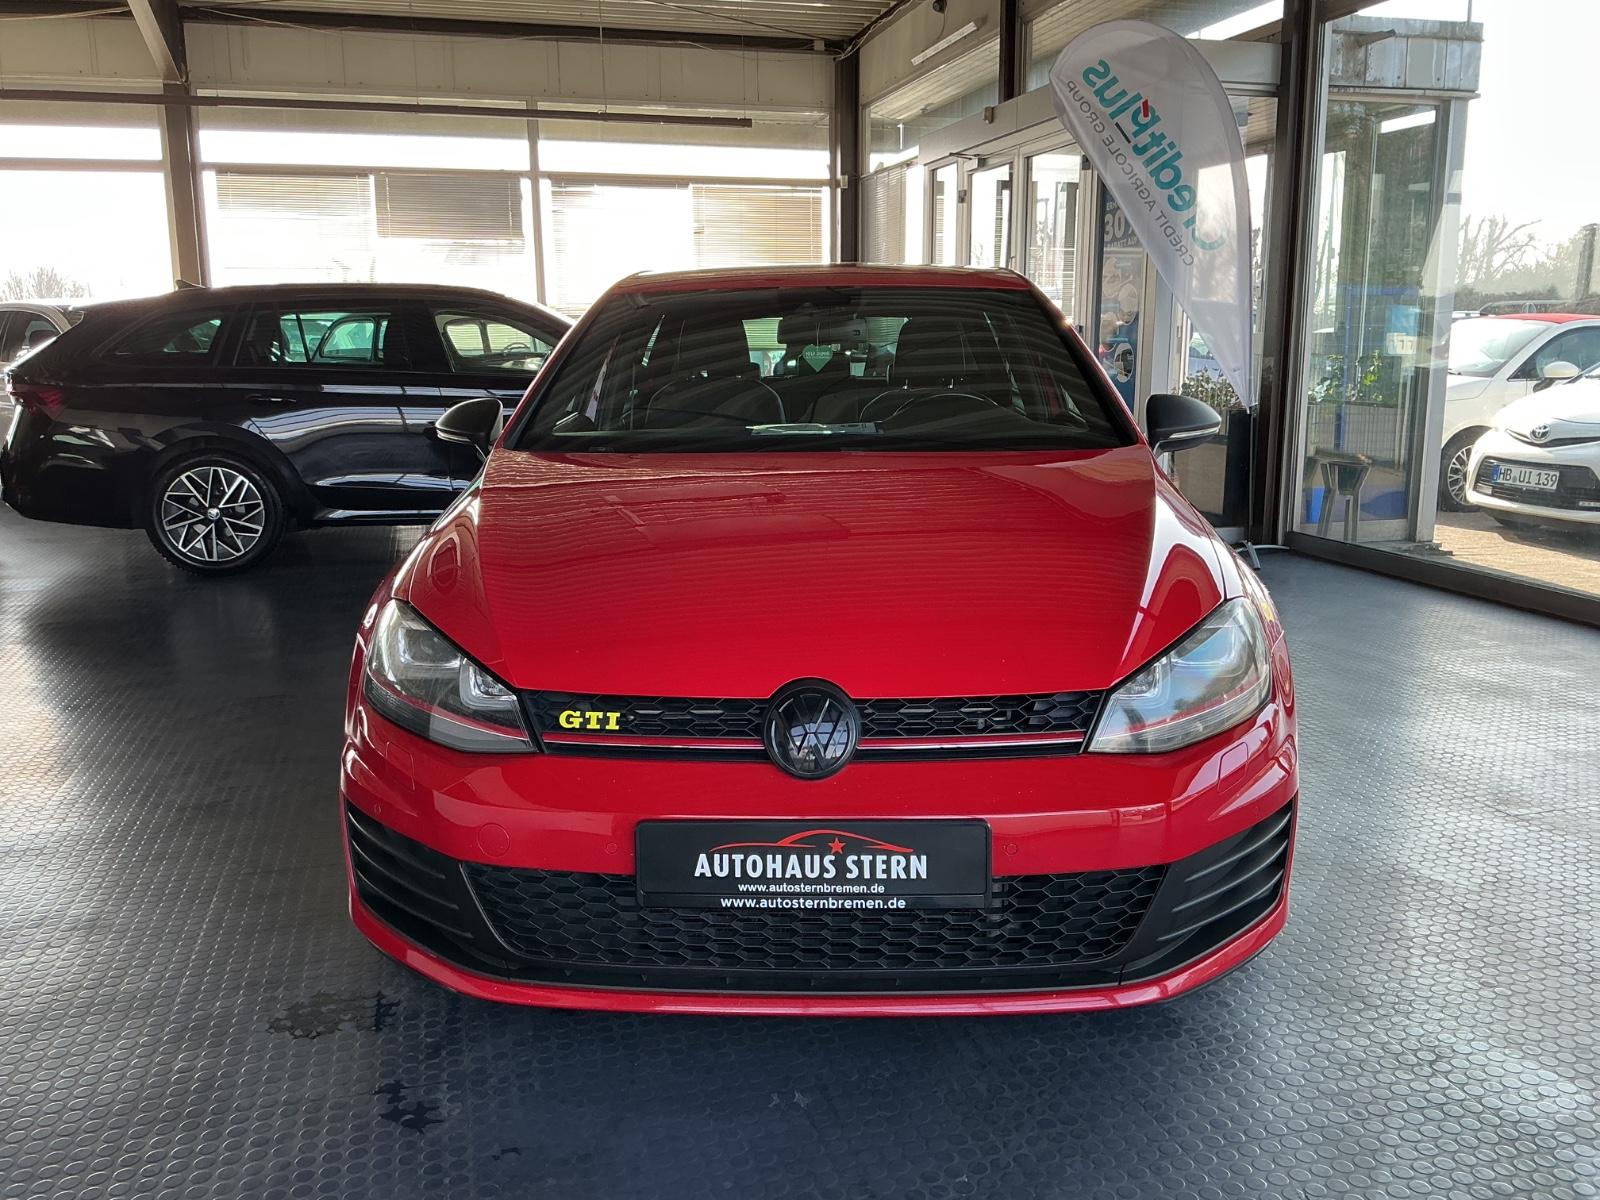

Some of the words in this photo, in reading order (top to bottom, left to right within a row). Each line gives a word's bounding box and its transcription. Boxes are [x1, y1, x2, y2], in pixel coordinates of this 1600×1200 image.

[1499, 467, 1512, 482] HB
[1535, 472, 1558, 488] 139
[558, 709, 621, 731] GTI
[771, 690, 852, 773] VW
[694, 853, 836, 879] AUTOHAUS
[845, 854, 928, 880] STERN
[737, 882, 885, 894] www.autosternbremen.de
[720, 896, 907, 910] www.autosternbremen.de
